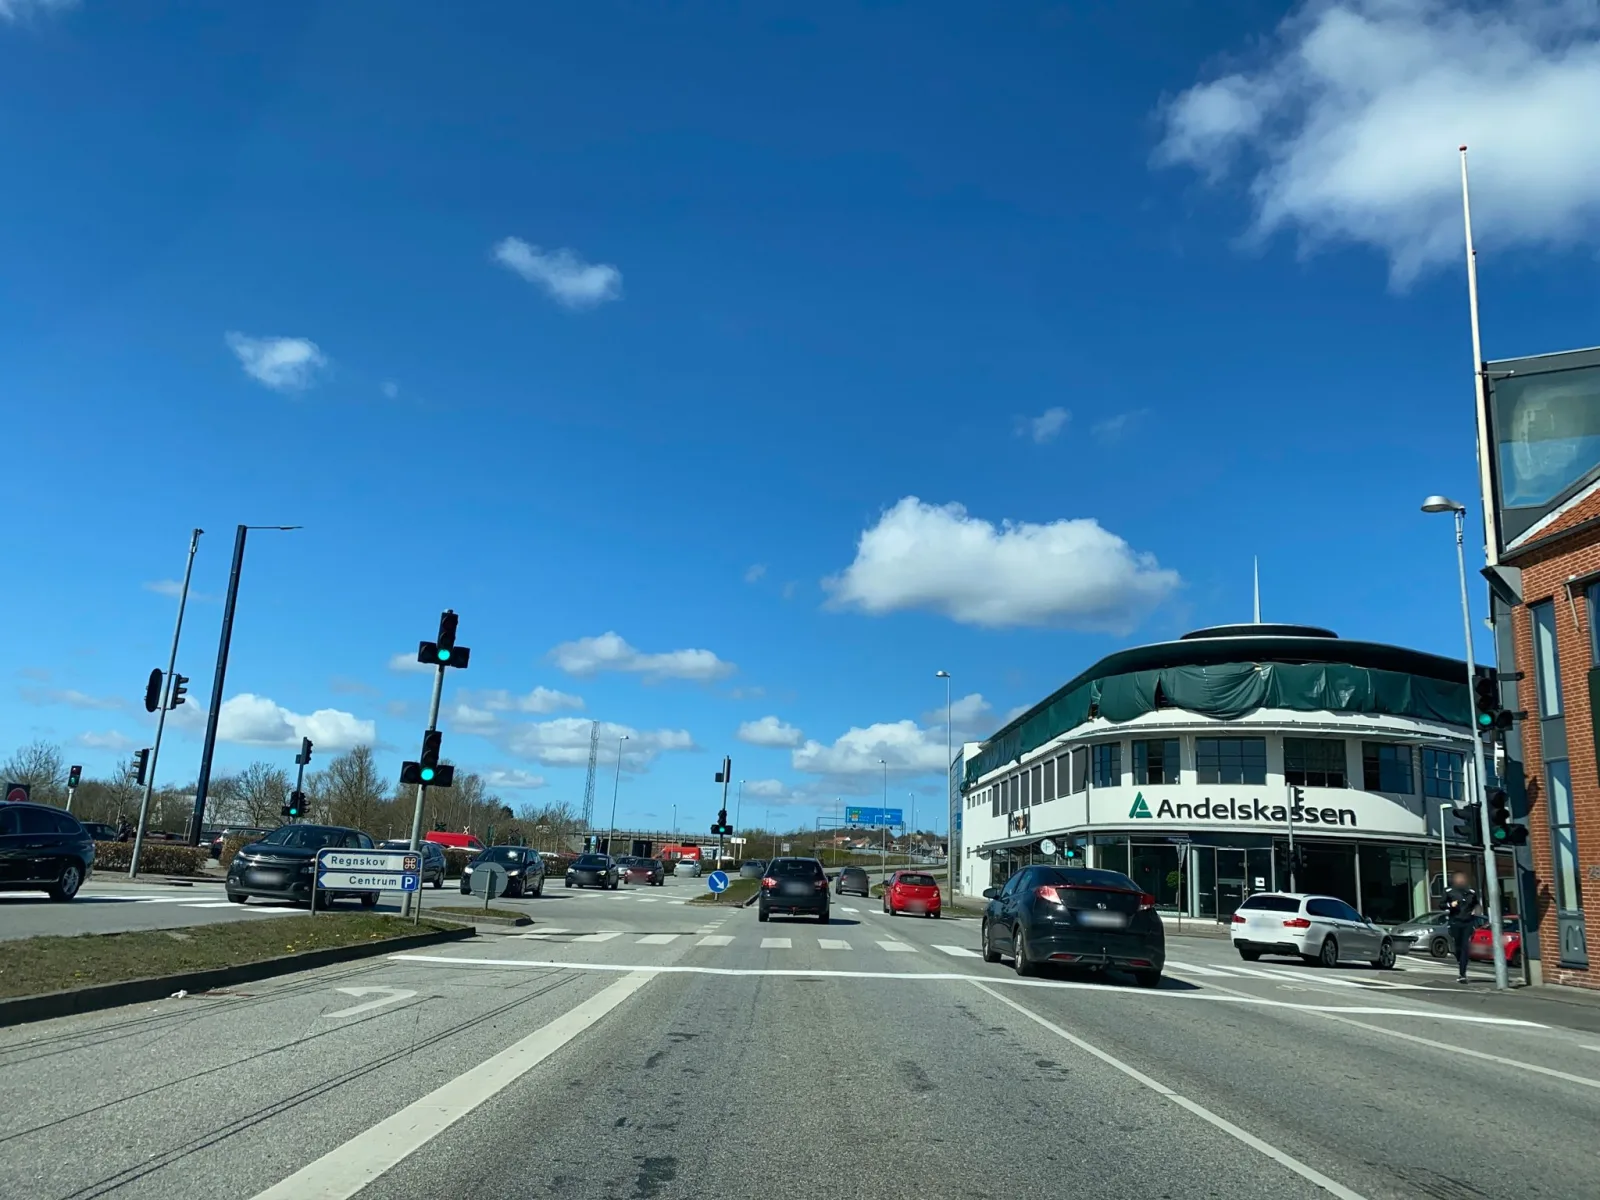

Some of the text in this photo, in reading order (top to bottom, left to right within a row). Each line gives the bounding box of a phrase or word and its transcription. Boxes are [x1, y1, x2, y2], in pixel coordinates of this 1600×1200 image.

[1156, 797, 1357, 827] Andelskassen
[331, 856, 385, 866] Regnskov
[349, 876, 413, 888] Centrum P
